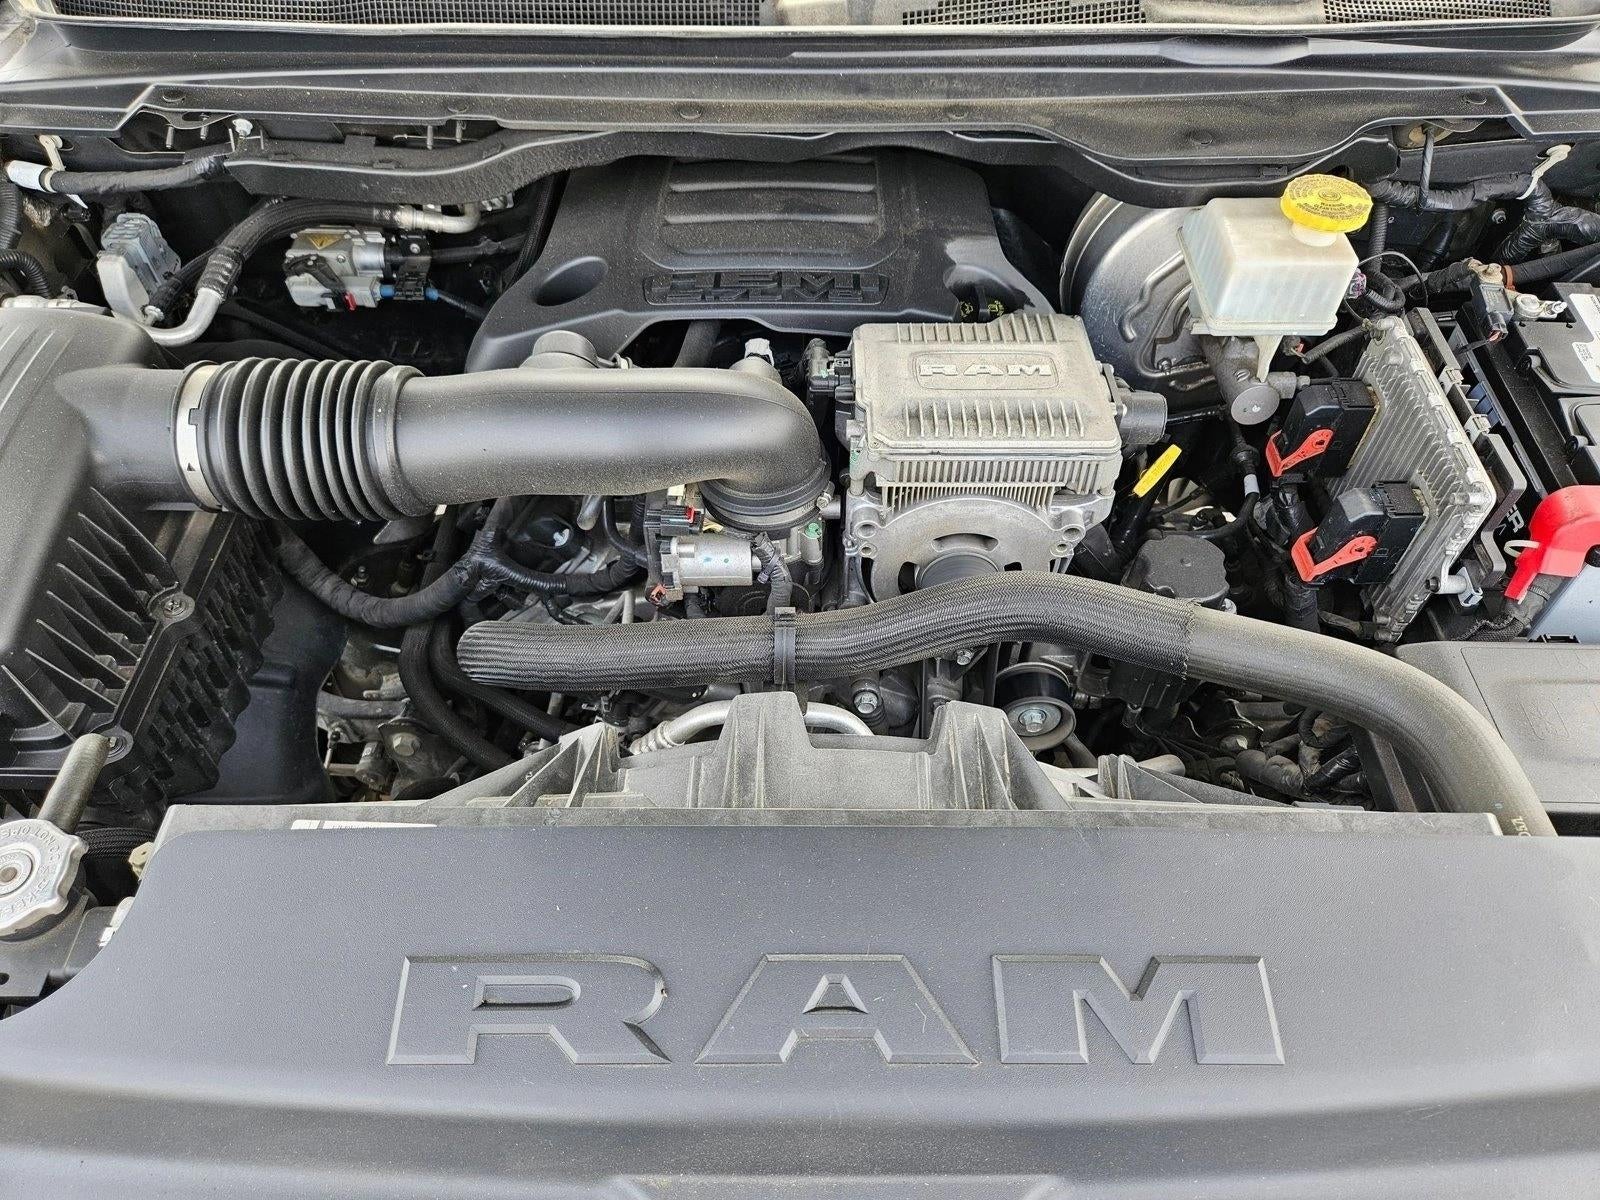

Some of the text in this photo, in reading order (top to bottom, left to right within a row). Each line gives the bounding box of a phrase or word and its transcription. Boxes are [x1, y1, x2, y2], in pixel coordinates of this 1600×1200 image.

[651, 271, 880, 289] HEMI
[919, 363, 1052, 377] RAM
[386, 953, 1286, 1065] RAM
